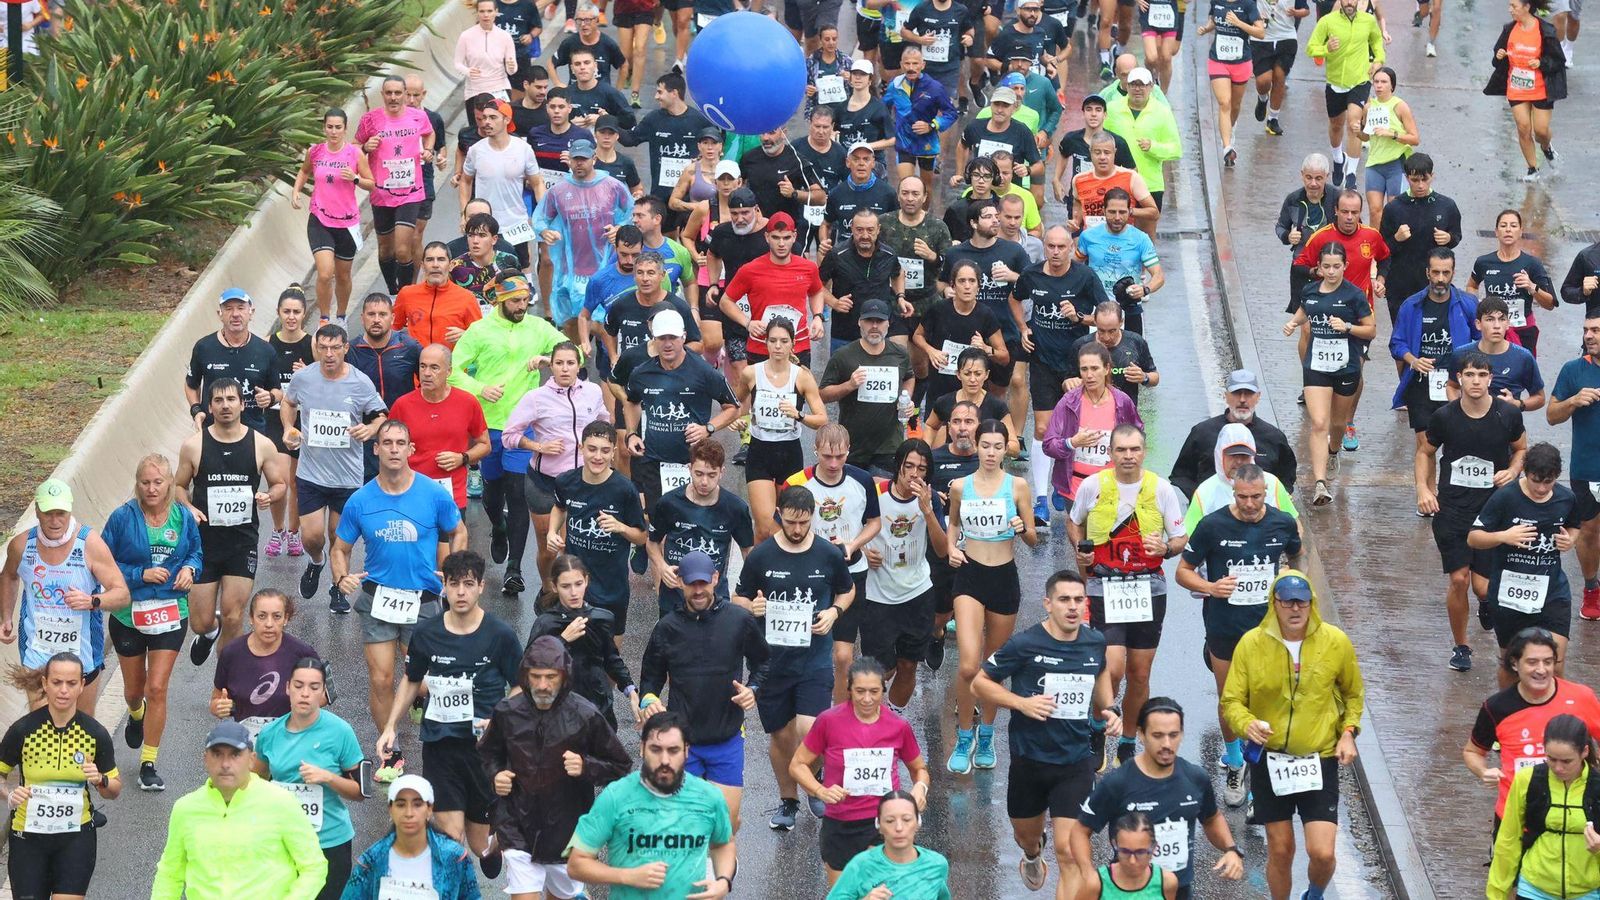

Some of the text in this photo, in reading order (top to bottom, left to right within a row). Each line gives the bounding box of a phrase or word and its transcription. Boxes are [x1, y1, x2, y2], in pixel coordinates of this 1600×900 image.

[1153, 13, 1171, 21] 6710
[926, 46, 945, 54] 6609
[1220, 45, 1239, 53] 6611
[821, 86, 842, 95] 1403
[389, 169, 411, 179] 1324
[904, 271, 918, 279] 52
[1319, 352, 1342, 361] 5112
[866, 381, 892, 391] 5261
[312, 424, 347, 436] 10007
[1459, 466, 1487, 476] 1194
[216, 502, 246, 513] 7029
[387, 520, 402, 529] THE
[965, 515, 1002, 526] 11017
[374, 528, 402, 538] NORTH
[1238, 581, 1268, 592] 5078
[1508, 587, 1539, 601] 6999
[382, 597, 413, 611] 7417
[1109, 598, 1148, 610] 11016
[144, 611, 169, 625] 336
[769, 620, 808, 632] 12771
[37, 629, 77, 643] 12786
[1052, 693, 1083, 705] 1393
[853, 768, 887, 780] 3847
[1274, 764, 1317, 780] 11493
[37, 804, 74, 817] 5358
[626, 828, 705, 854] jarana
